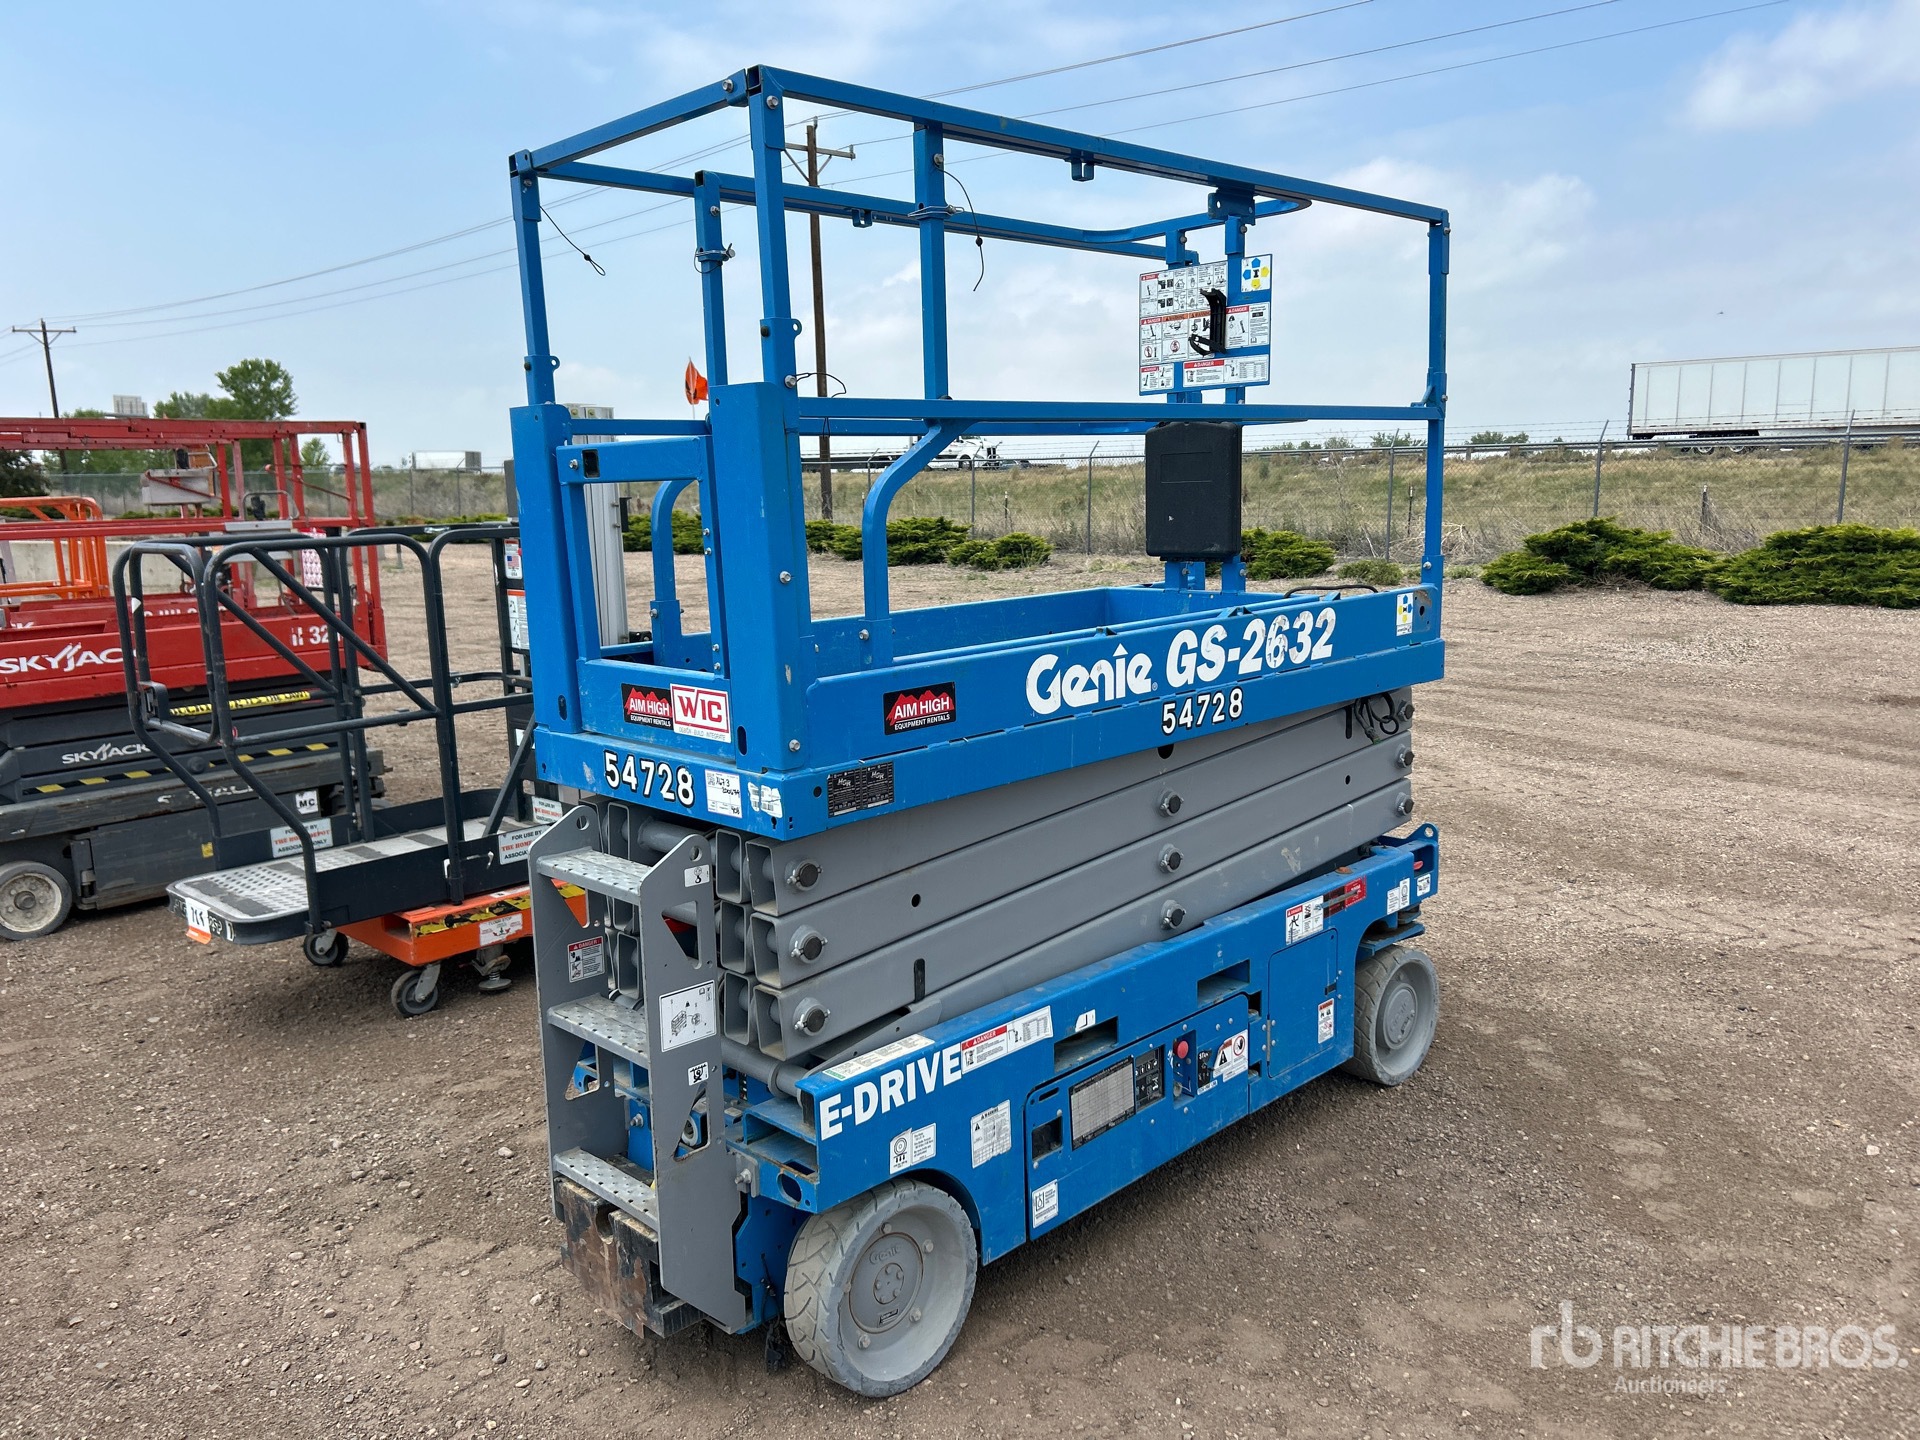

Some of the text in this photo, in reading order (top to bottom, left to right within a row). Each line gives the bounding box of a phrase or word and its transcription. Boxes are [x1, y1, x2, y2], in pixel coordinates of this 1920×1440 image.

[0, 642, 137, 674] SKYJAC
[1026, 606, 1337, 715] Genie GS-2632
[629, 698, 670, 716] AIM HIGH
[630, 715, 671, 727] EQUIPMENT RENTALS
[678, 693, 723, 723] WIC
[894, 696, 950, 720] AIM HIGH
[894, 713, 950, 731] EQUIPMENT RENTALS
[1161, 687, 1243, 736] 54728
[62, 743, 151, 764] SKYJACK
[603, 749, 695, 809] 54728
[819, 1043, 963, 1141] E-DRIVE
